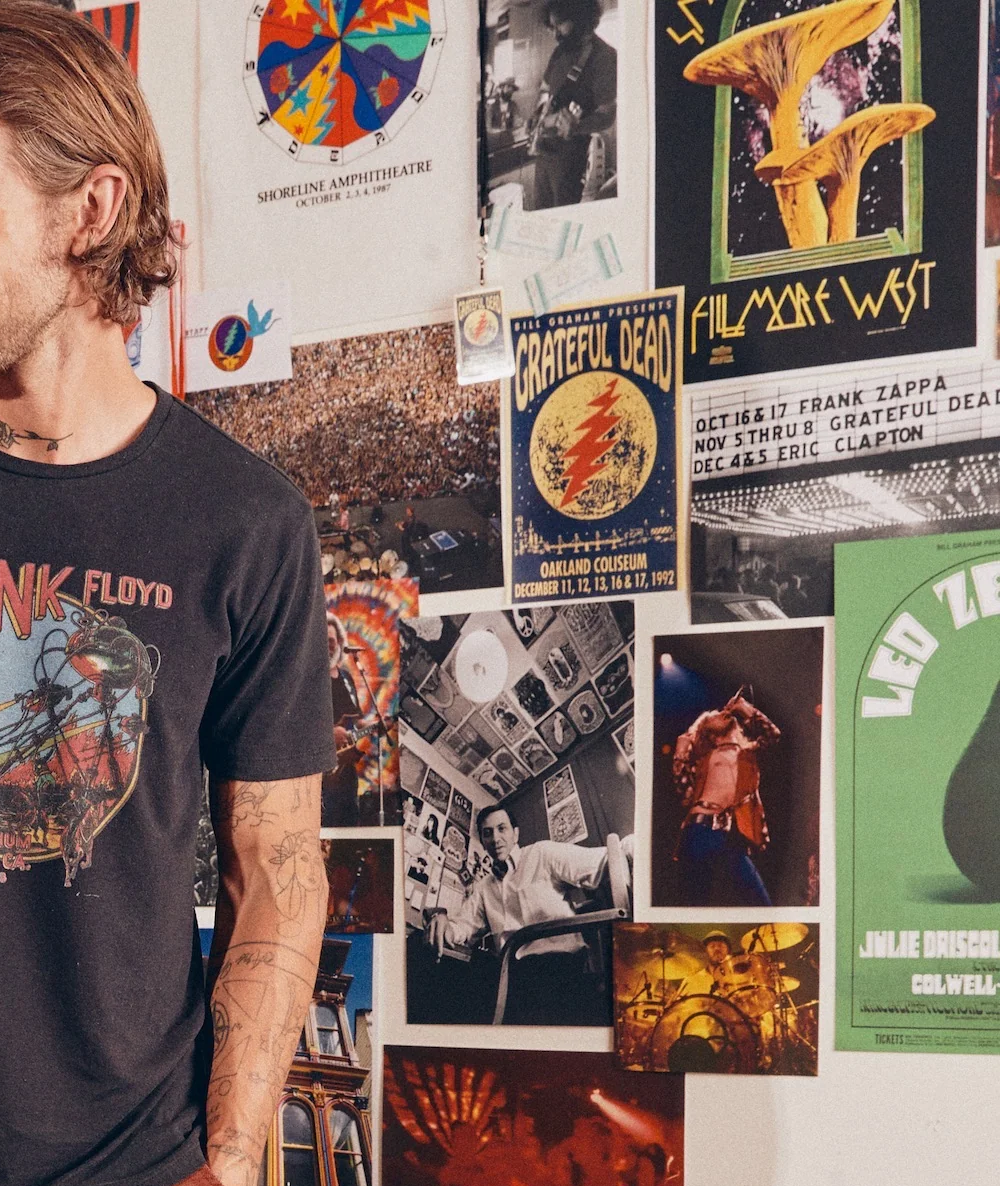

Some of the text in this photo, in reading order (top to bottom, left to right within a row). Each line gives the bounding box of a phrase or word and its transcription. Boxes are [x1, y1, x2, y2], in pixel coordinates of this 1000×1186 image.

[258, 160, 433, 204] SHORELINE AMPHITHEATRE
[296, 191, 341, 208] OCTOBER
[373, 183, 391, 195] 1987
[838, 259, 936, 324] WEST
[514, 300, 672, 331] BILL GRAHAM PRESENTS
[515, 313, 672, 411] GRATEFUL DEAD
[695, 387, 1000, 454] NOV 5 THRU 8 GRATEFUL DEAD
[696, 414, 729, 433] OCT
[800, 390, 863, 415] FRANK
[876, 375, 947, 401] ZAPPA
[694, 457, 725, 474] DEC
[778, 440, 819, 461] ERIC
[835, 425, 923, 452] CLAPTON
[514, 569, 675, 598] DECEMBER 11, 12, 13, 16 & 17, 1992
[540, 553, 647, 579] OAKLAND COLISEUM
[83, 568, 173, 609] FLOYD
[861, 611, 939, 719] LED
[859, 930, 920, 958] JULIE
[875, 1034, 904, 1045] TICKETS
